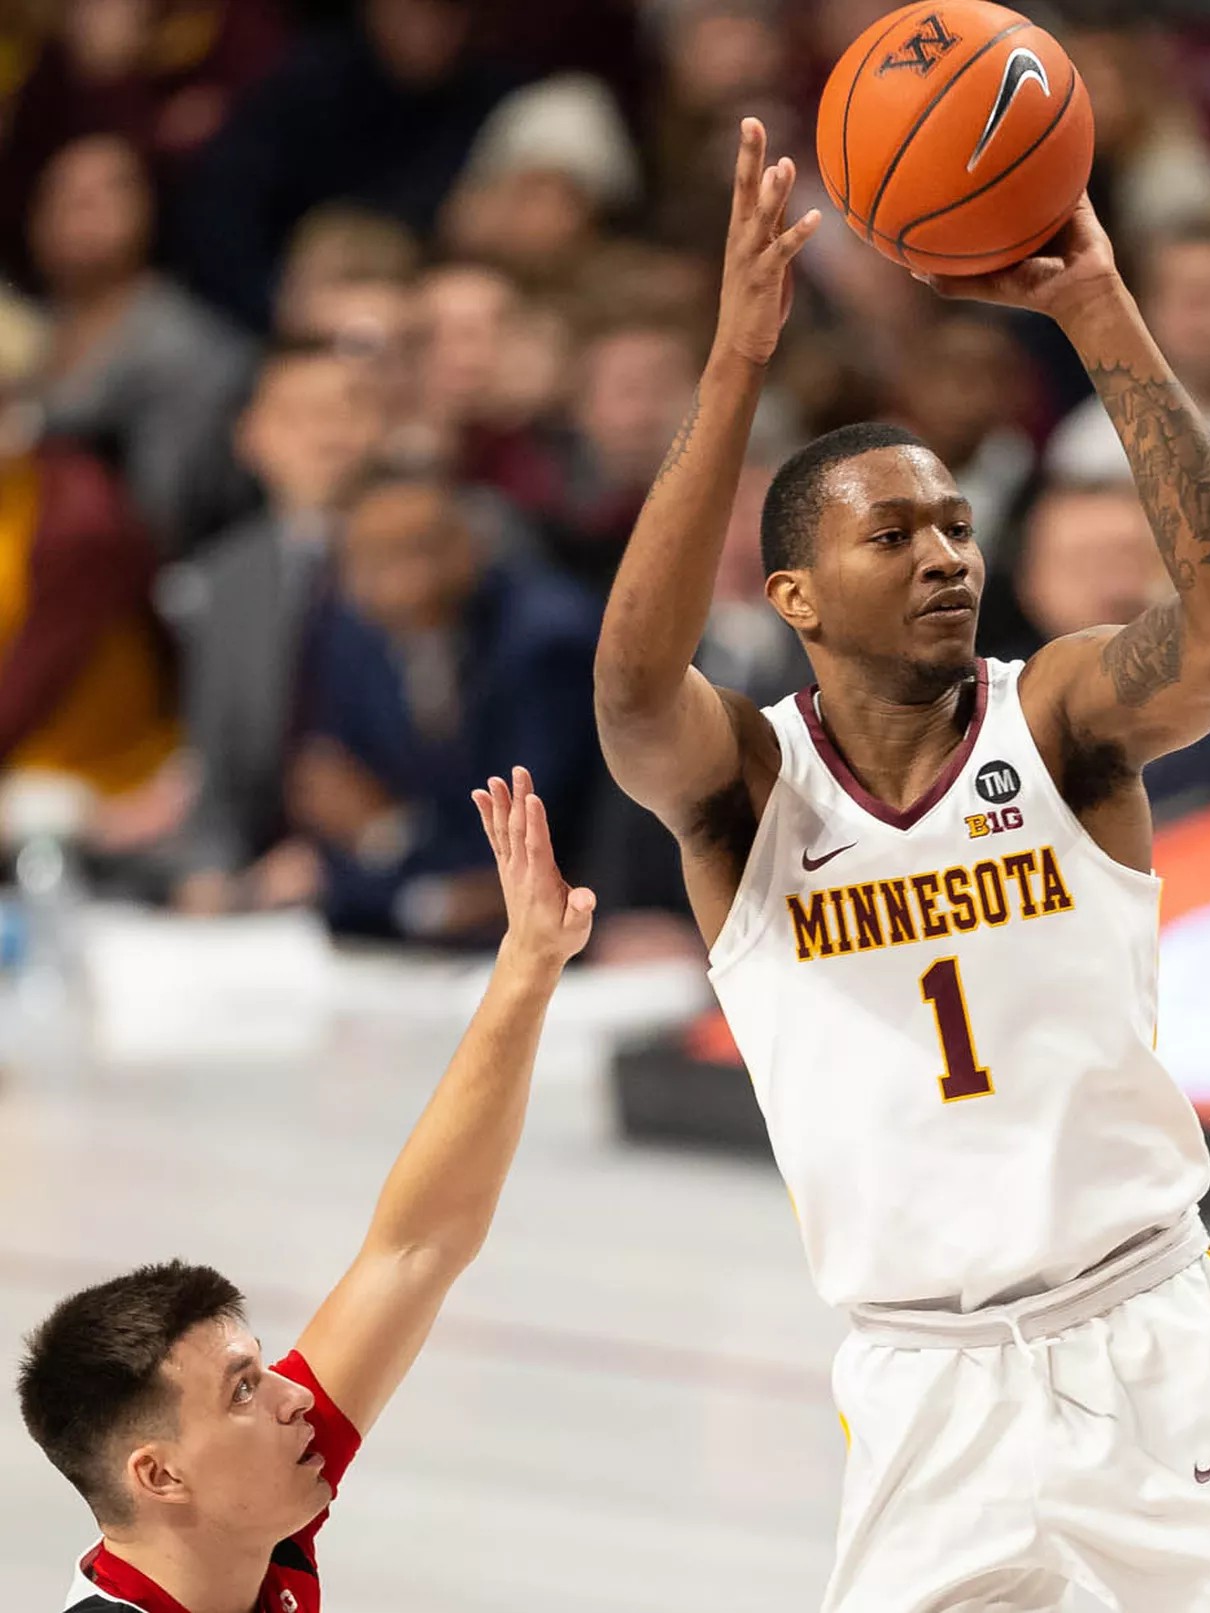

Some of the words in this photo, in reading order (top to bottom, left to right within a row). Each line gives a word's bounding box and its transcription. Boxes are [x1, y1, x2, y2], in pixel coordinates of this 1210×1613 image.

[979, 768, 1016, 797] TM
[785, 845, 1074, 962] MINNESOTA
[919, 955, 996, 1103] 1
